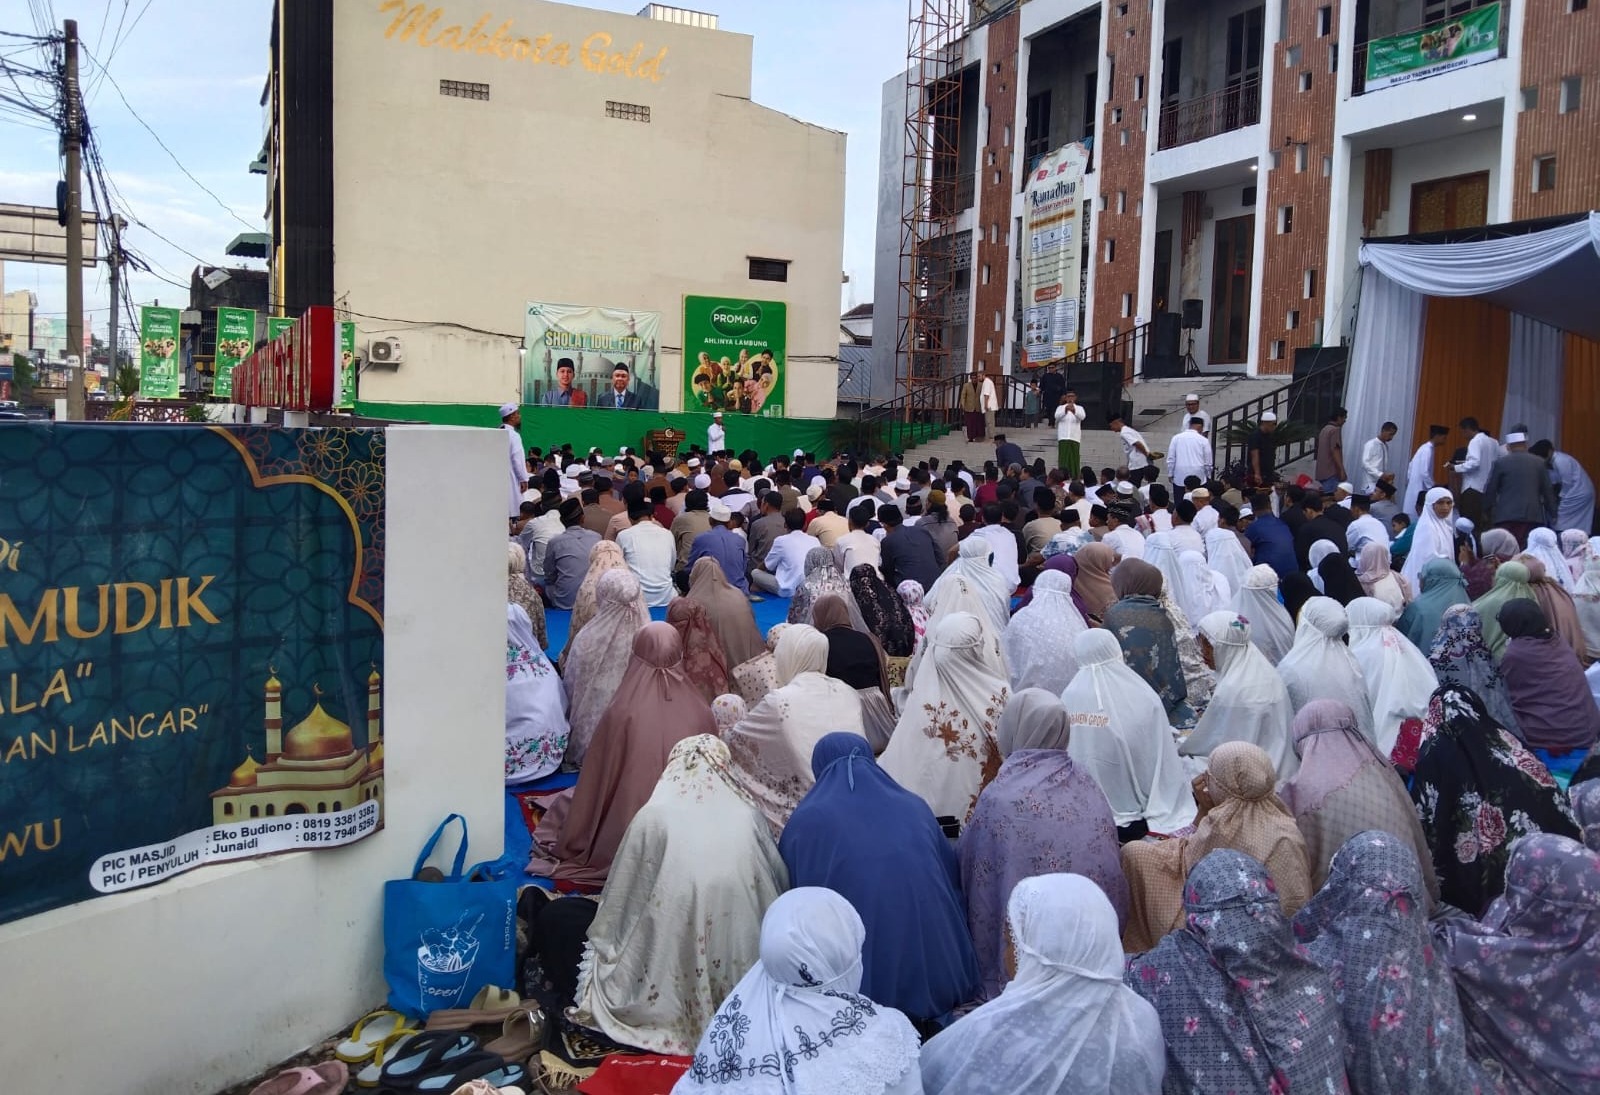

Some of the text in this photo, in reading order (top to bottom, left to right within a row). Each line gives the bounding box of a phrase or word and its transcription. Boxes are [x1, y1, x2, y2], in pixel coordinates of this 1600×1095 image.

[579, 31, 668, 82] Gold
[1030, 181, 1076, 206] Ramadhan
[545, 331, 588, 347] SHOLAT
[591, 334, 614, 349] IDUL
[618, 336, 644, 352] FITRI
[713, 313, 758, 325] PROMAG
[0, 575, 221, 648] MUDIK
[0, 662, 93, 716] LA"
[0, 729, 56, 764] AN
[101, 856, 126, 873] PIC
[129, 844, 177, 867] MASJID
[212, 830, 237, 842] Eko
[240, 821, 293, 838] Budiono
[302, 818, 331, 829] 0819
[334, 812, 358, 827] 3381
[358, 803, 376, 819] 3382
[102, 872, 128, 888] PIC
[137, 848, 200, 880] PENYULUH
[211, 838, 259, 855] Junaidi
[302, 831, 332, 842] 0812
[334, 826, 358, 840] 7940
[358, 815, 376, 831] 5255
